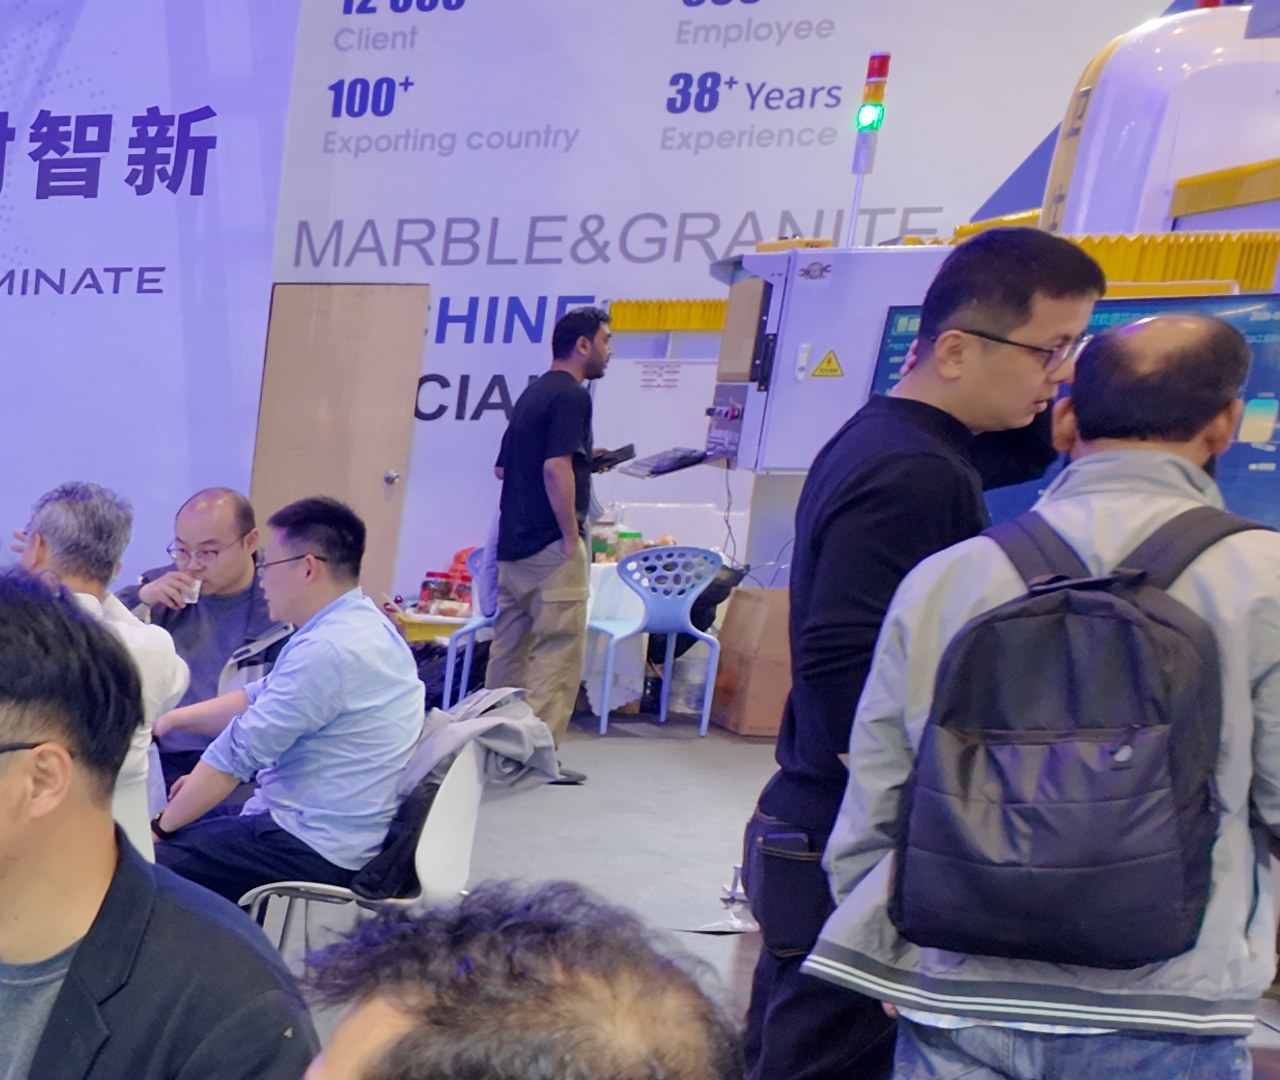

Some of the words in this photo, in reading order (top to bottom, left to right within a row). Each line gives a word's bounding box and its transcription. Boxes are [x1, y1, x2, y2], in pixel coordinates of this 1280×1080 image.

[333, 25, 419, 51] Client
[675, 17, 836, 48] Employee
[328, 76, 415, 118] 100+
[666, 71, 739, 114] 38+
[745, 82, 842, 111] Years
[322, 128, 457, 157] Exporting
[465, 124, 580, 152] country
[660, 124, 838, 155] Experience
